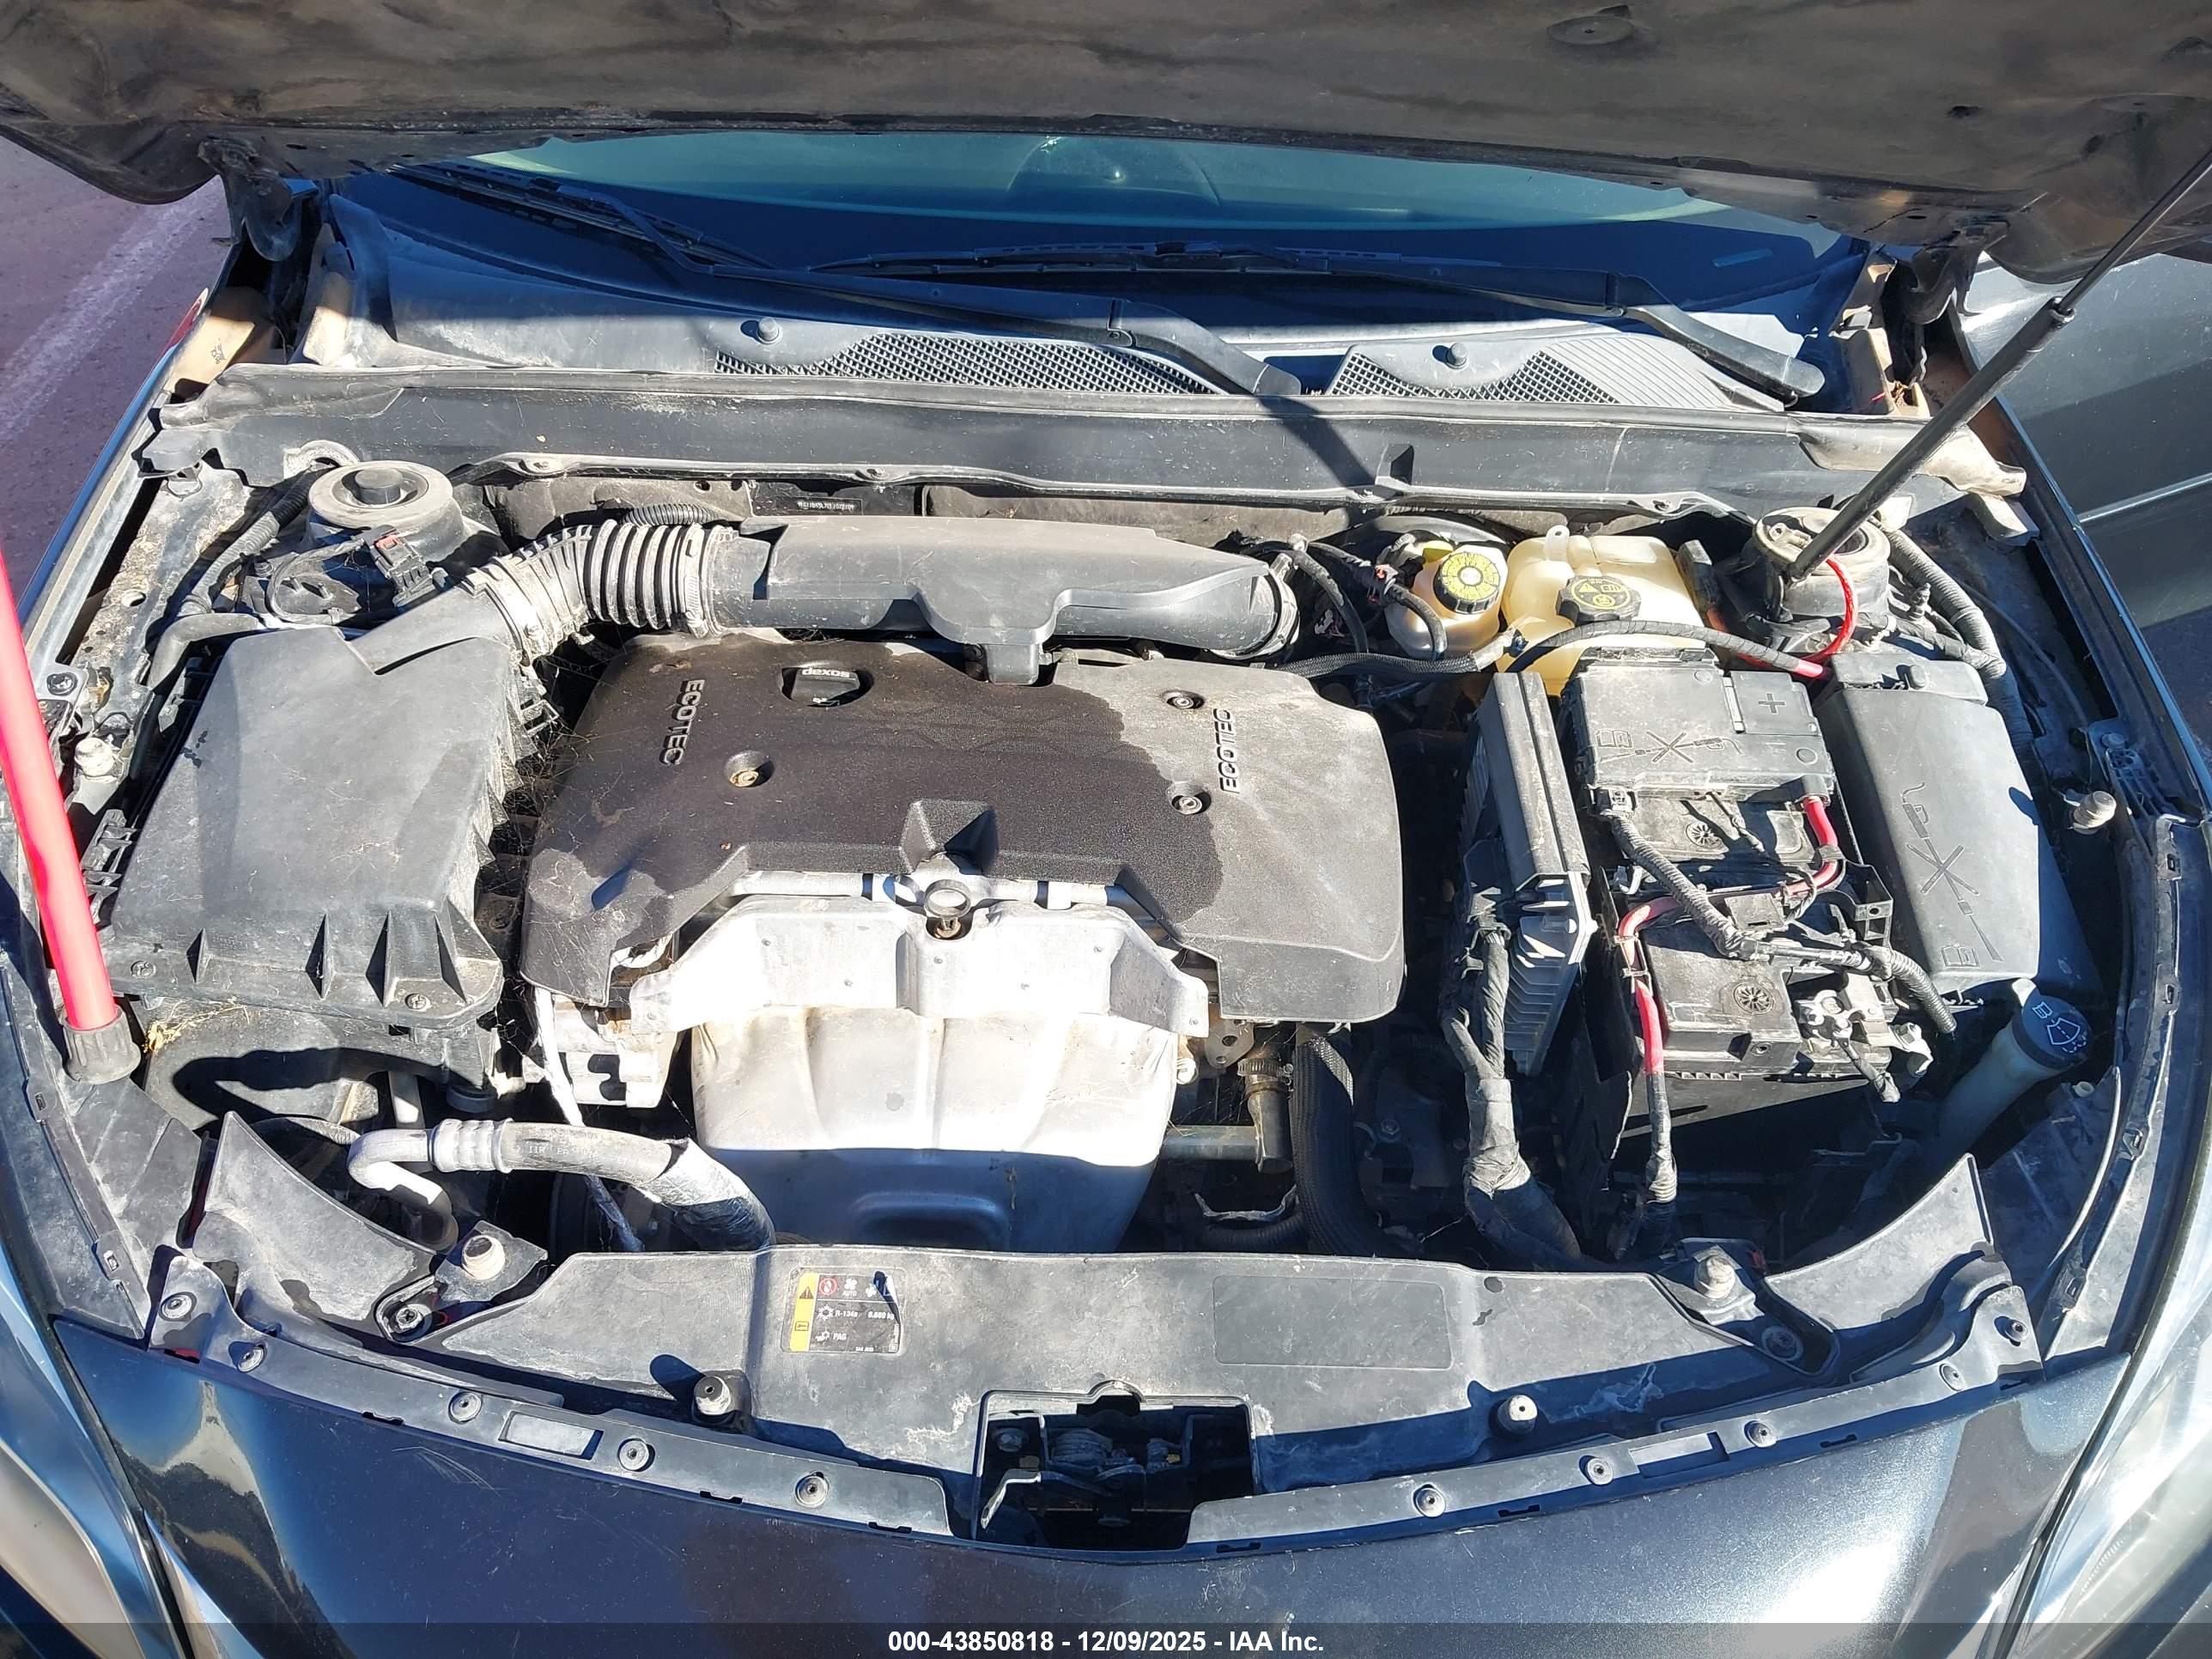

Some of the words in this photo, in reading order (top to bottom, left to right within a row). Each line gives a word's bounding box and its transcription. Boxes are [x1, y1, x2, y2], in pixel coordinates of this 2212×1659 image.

[802, 667, 850, 678] dexos
[661, 679, 705, 765] ECOTEC
[1213, 708, 1239, 793] ECOTEC
